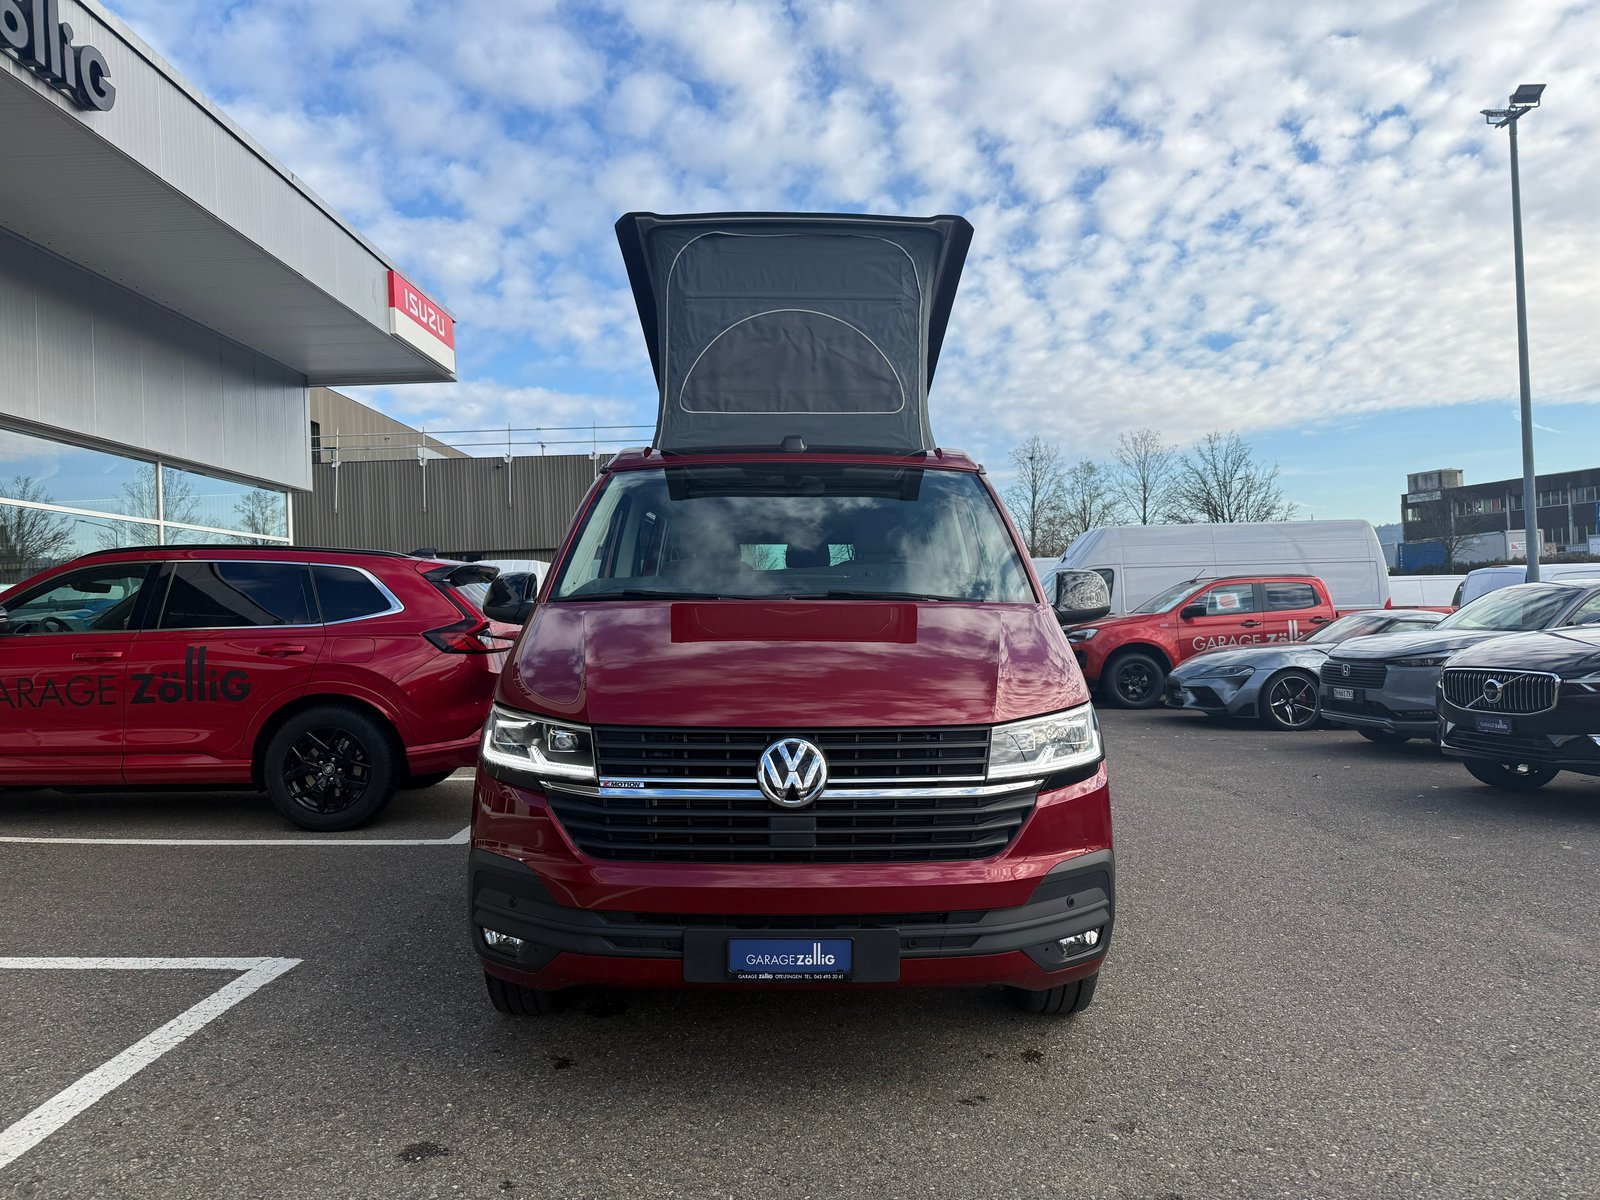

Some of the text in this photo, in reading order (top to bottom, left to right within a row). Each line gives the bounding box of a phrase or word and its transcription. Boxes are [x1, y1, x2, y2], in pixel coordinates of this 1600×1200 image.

[404, 287, 446, 338] ISUZU
[1192, 634, 1261, 651] GARAGE
[746, 954, 795, 966] GARAGE
